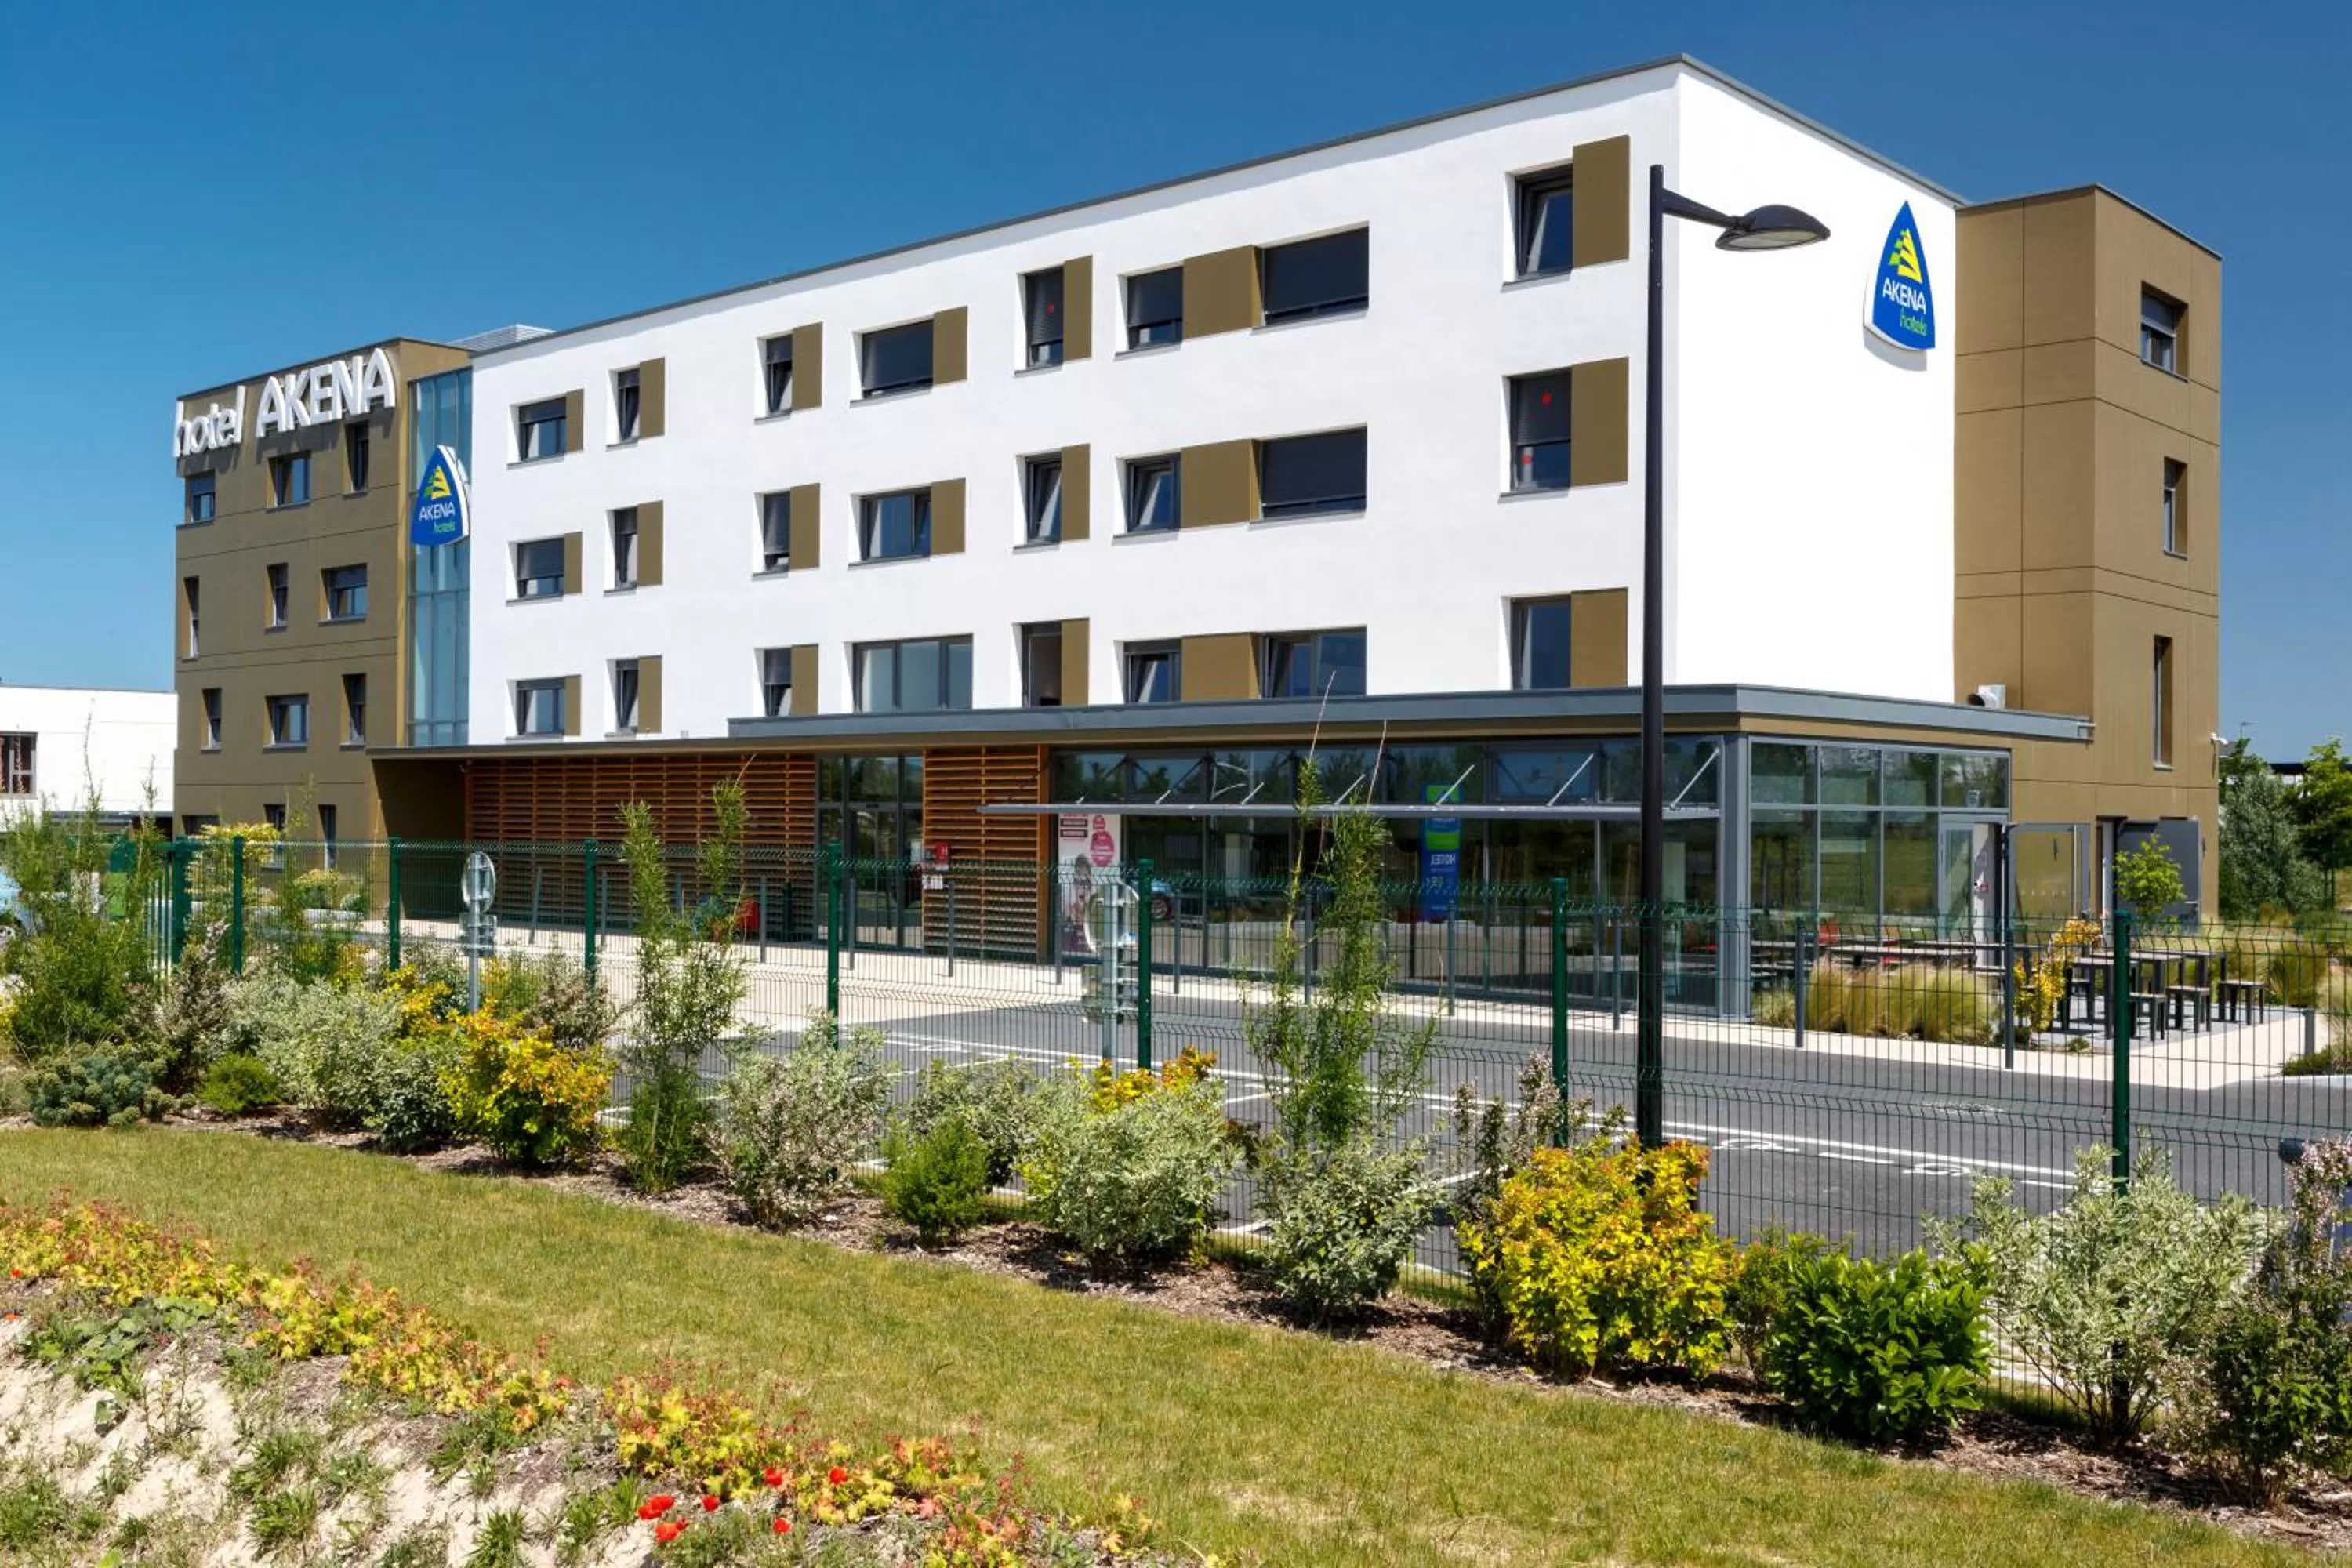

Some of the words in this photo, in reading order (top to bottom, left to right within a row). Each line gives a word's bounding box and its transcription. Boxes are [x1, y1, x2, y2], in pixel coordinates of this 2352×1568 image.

[1882, 277, 1926, 314] AKENA
[1900, 307, 1928, 336] hotels
[173, 385, 246, 458] hotel
[256, 347, 395, 437] AKENA
[418, 501, 456, 521] AKENA
